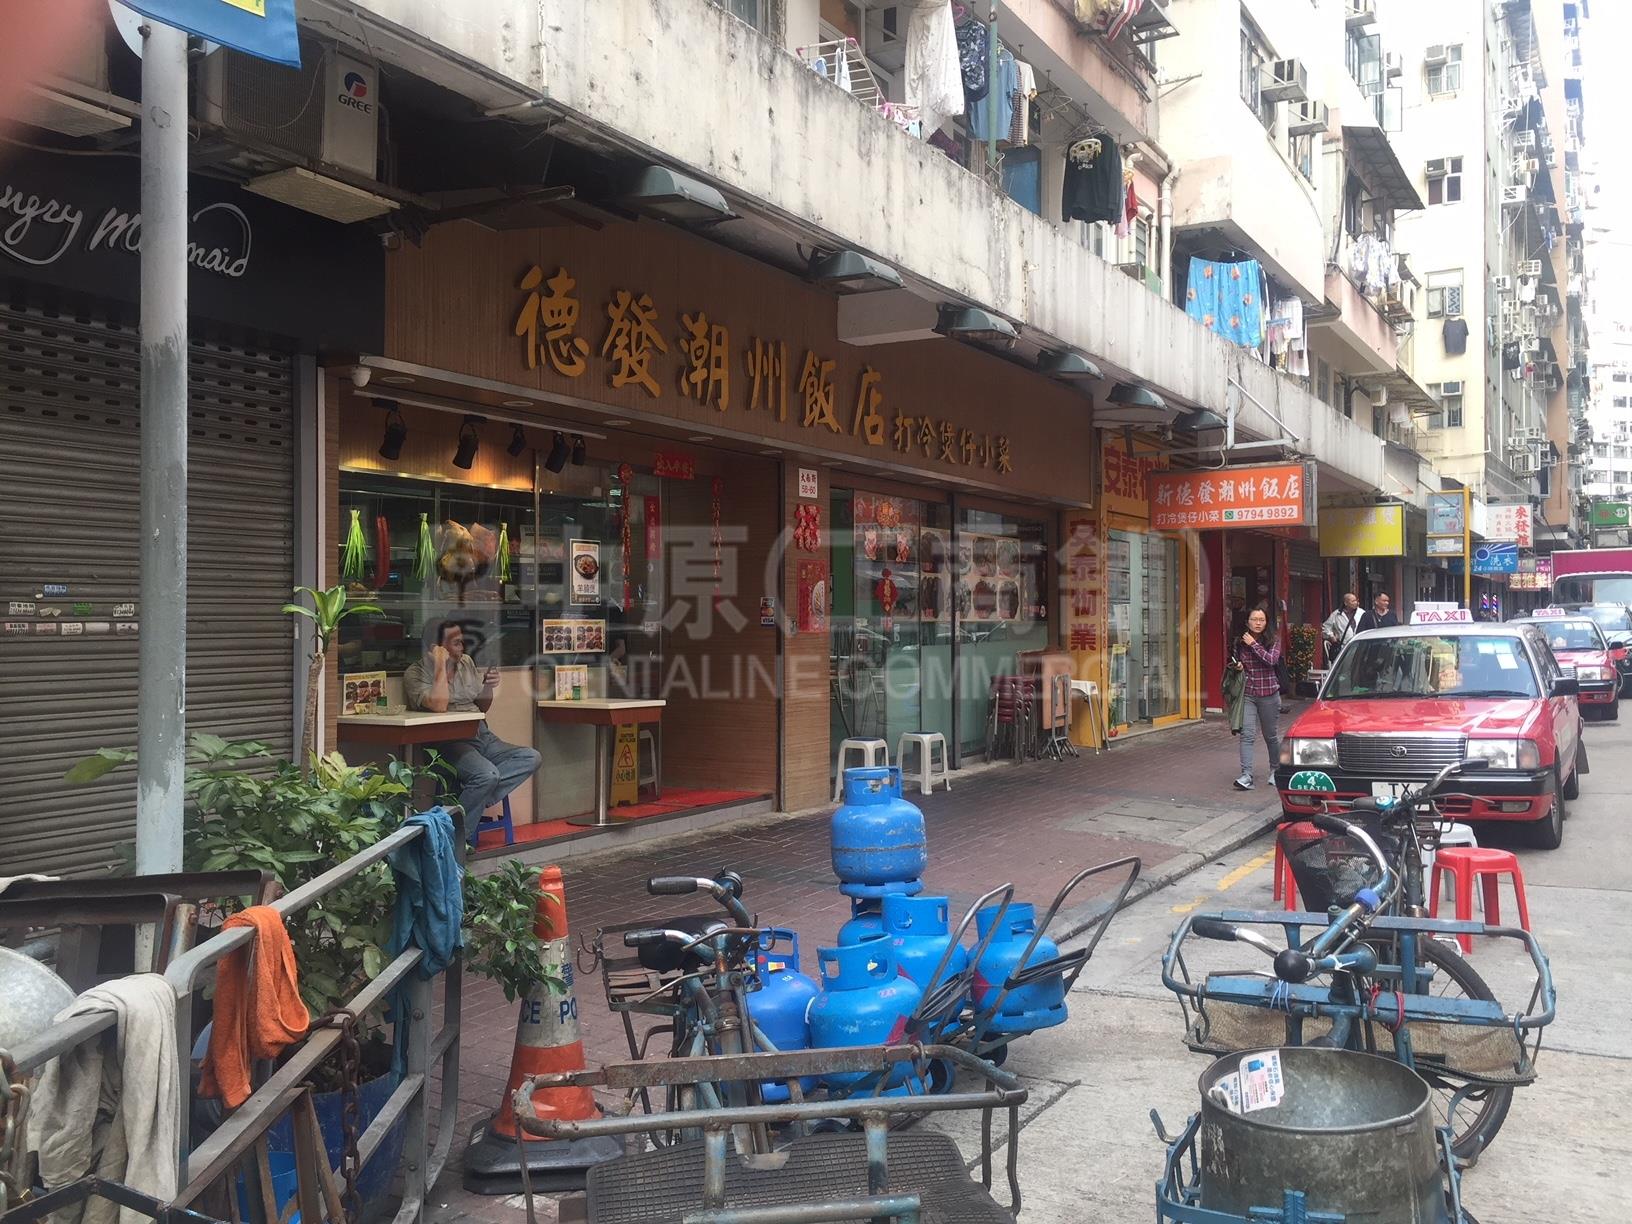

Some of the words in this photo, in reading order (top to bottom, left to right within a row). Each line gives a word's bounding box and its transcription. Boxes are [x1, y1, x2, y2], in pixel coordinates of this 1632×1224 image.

[338, 94, 372, 114] GREE
[0, 185, 83, 264] ngry
[515, 264, 884, 447] 德發潮州飯店
[1155, 473, 1301, 507] 新德發潮州飯店
[1237, 508, 1264, 520] 9794
[1267, 507, 1295, 519] 9892
[1417, 610, 1467, 622] TAXI
[1534, 608, 1562, 616] TAXI
[1307, 776, 1316, 786] 4
